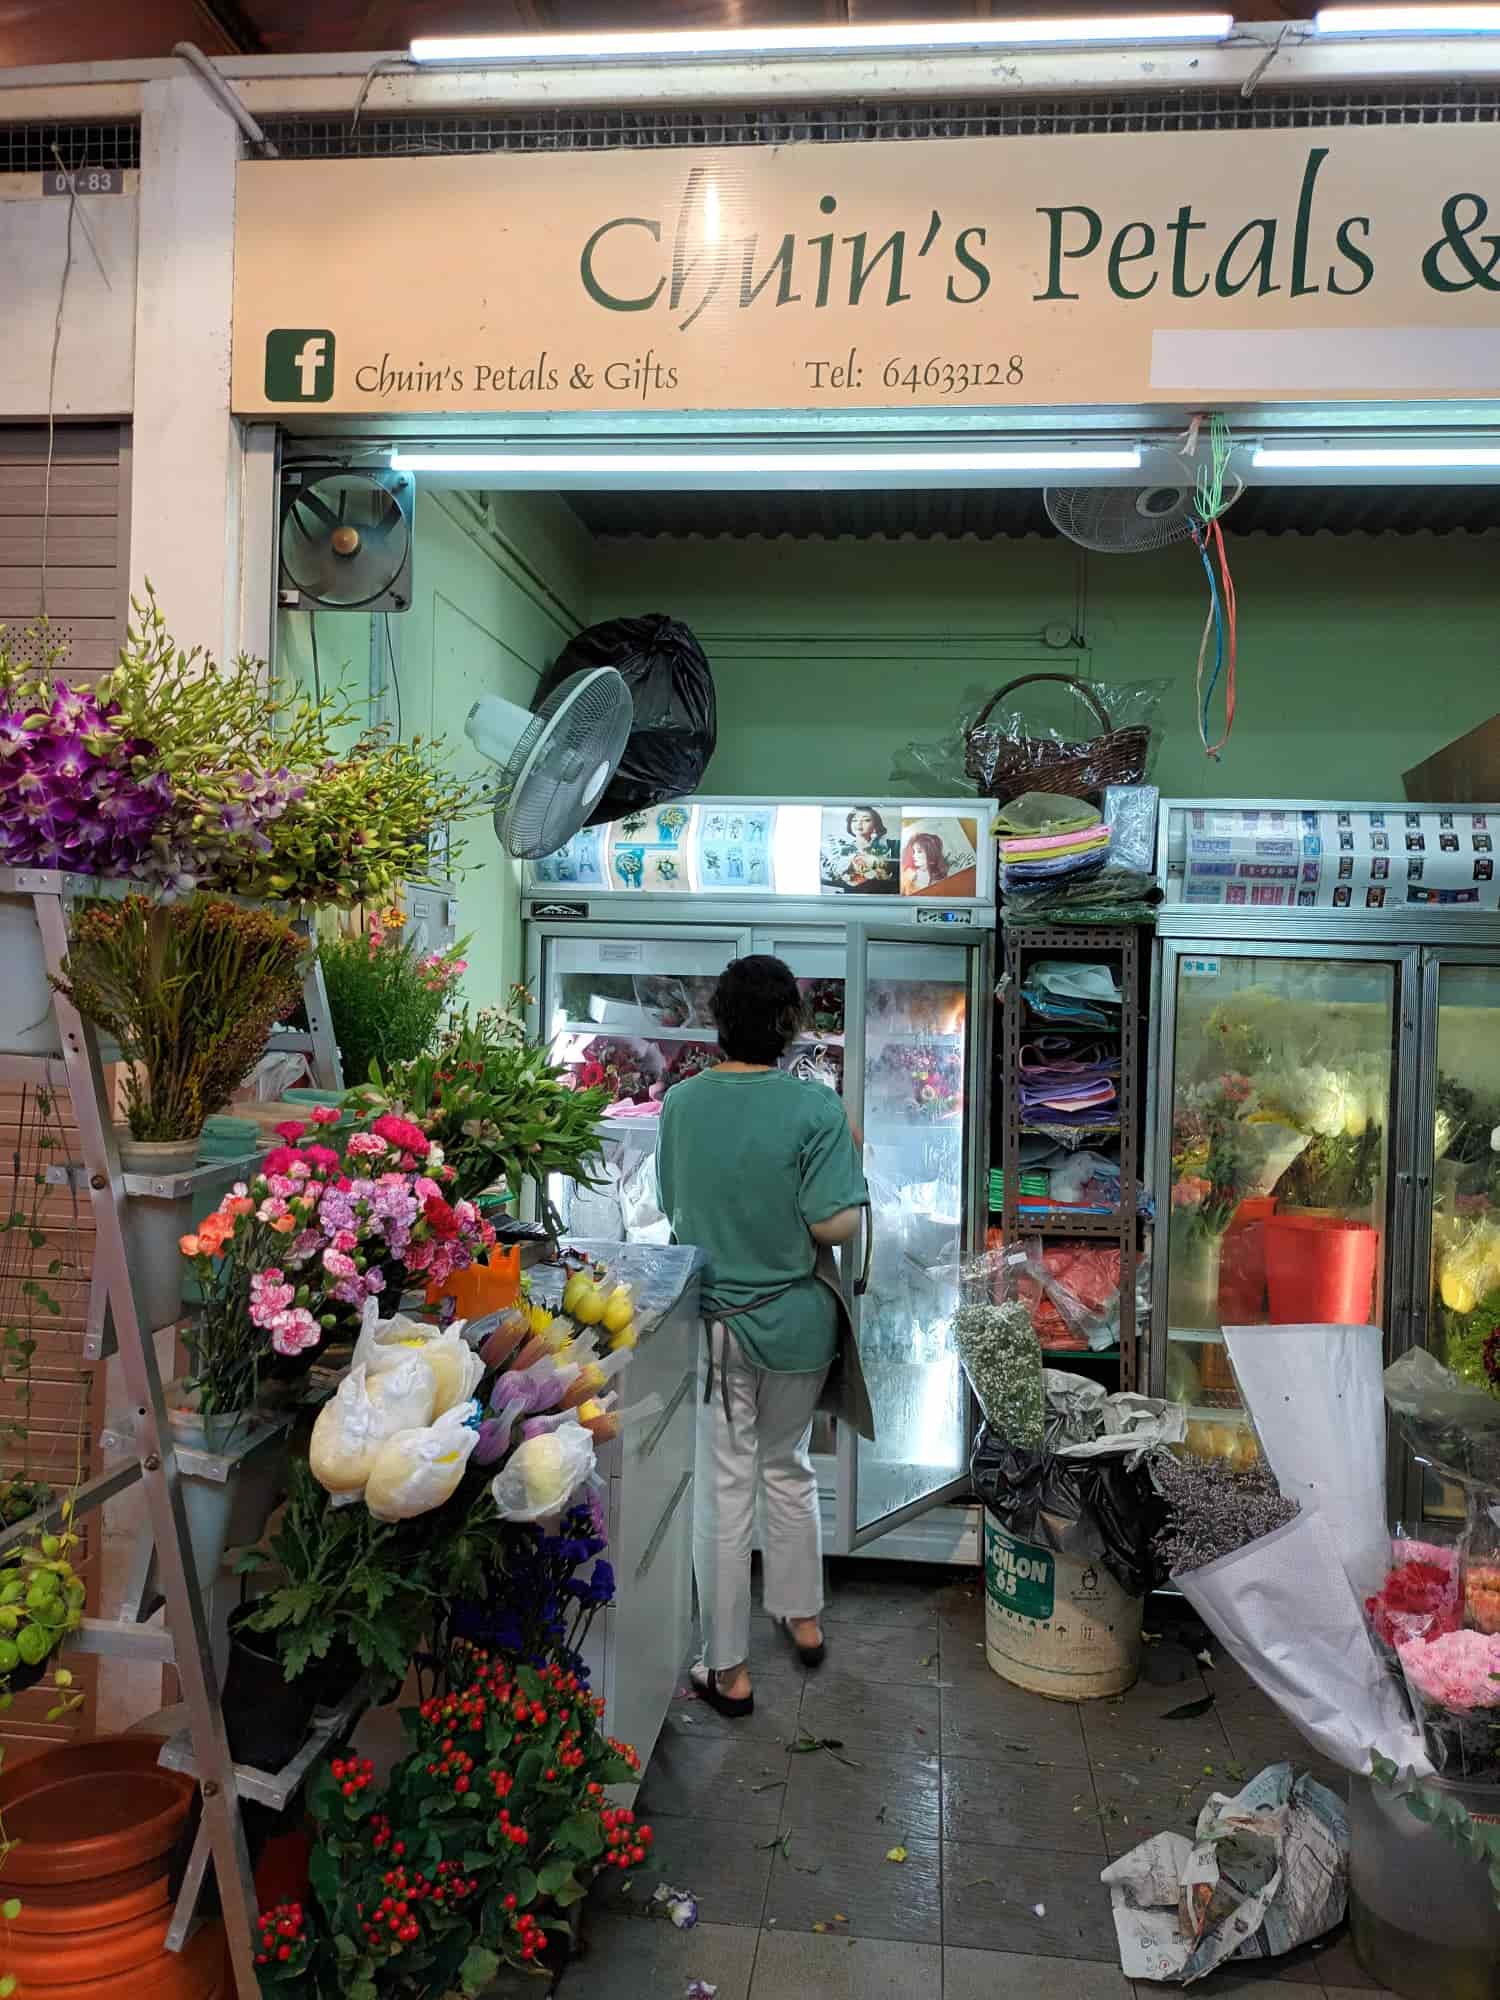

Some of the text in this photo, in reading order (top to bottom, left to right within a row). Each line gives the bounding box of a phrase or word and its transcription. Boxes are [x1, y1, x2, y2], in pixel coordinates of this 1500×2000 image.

[55, 174, 112, 191] 01-83
[580, 147, 1500, 331] Chuin's Petals &
[355, 350, 679, 401] Chuin's Petals & Gifts
[805, 347, 1025, 394] Tel: 64633128
